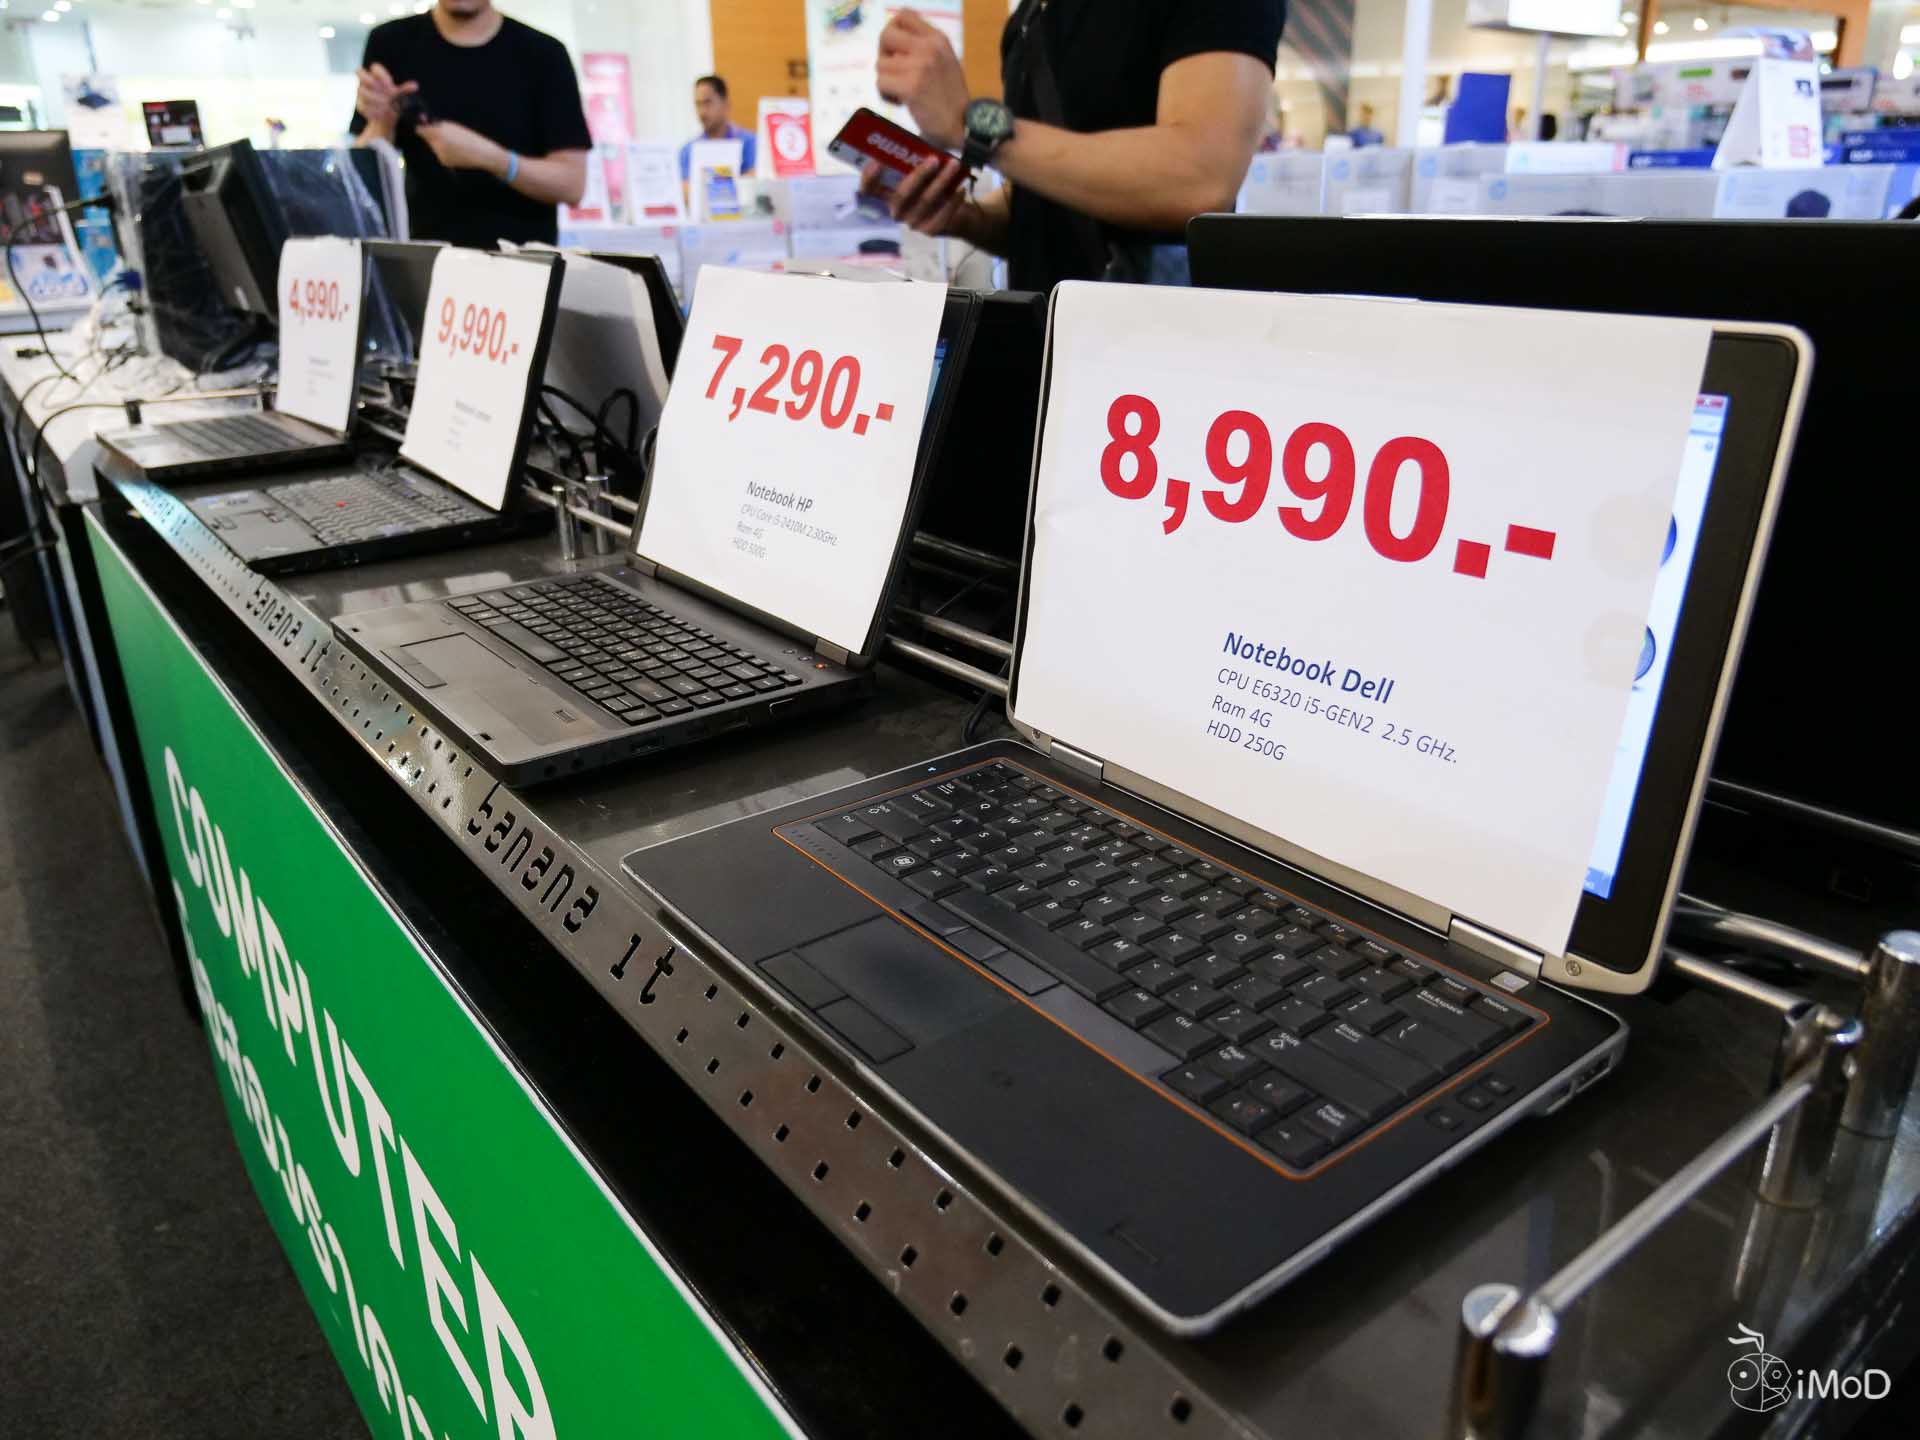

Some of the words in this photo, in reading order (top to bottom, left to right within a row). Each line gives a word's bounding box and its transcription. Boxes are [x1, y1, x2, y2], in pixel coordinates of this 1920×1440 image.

[438, 297, 519, 365] 9,990.-
[705, 334, 895, 436] 7,290.-
[747, 481, 796, 509] Notebook
[796, 496, 813, 513] HP
[1100, 394, 1556, 580] 8,990.-
[1223, 632, 1336, 687] Notebook
[1340, 668, 1394, 704] Dell
[1206, 719, 1242, 743] HDD
[1243, 733, 1288, 761] 250G
[1211, 695, 1246, 719] Ram
[1250, 708, 1273, 728] 4G
[1217, 668, 1250, 691] CPU
[1251, 679, 1302, 709] E6320
[1303, 695, 1374, 734] i5-GEN2
[1381, 723, 1412, 746] 2.5
[1416, 735, 1458, 764] GHz.
